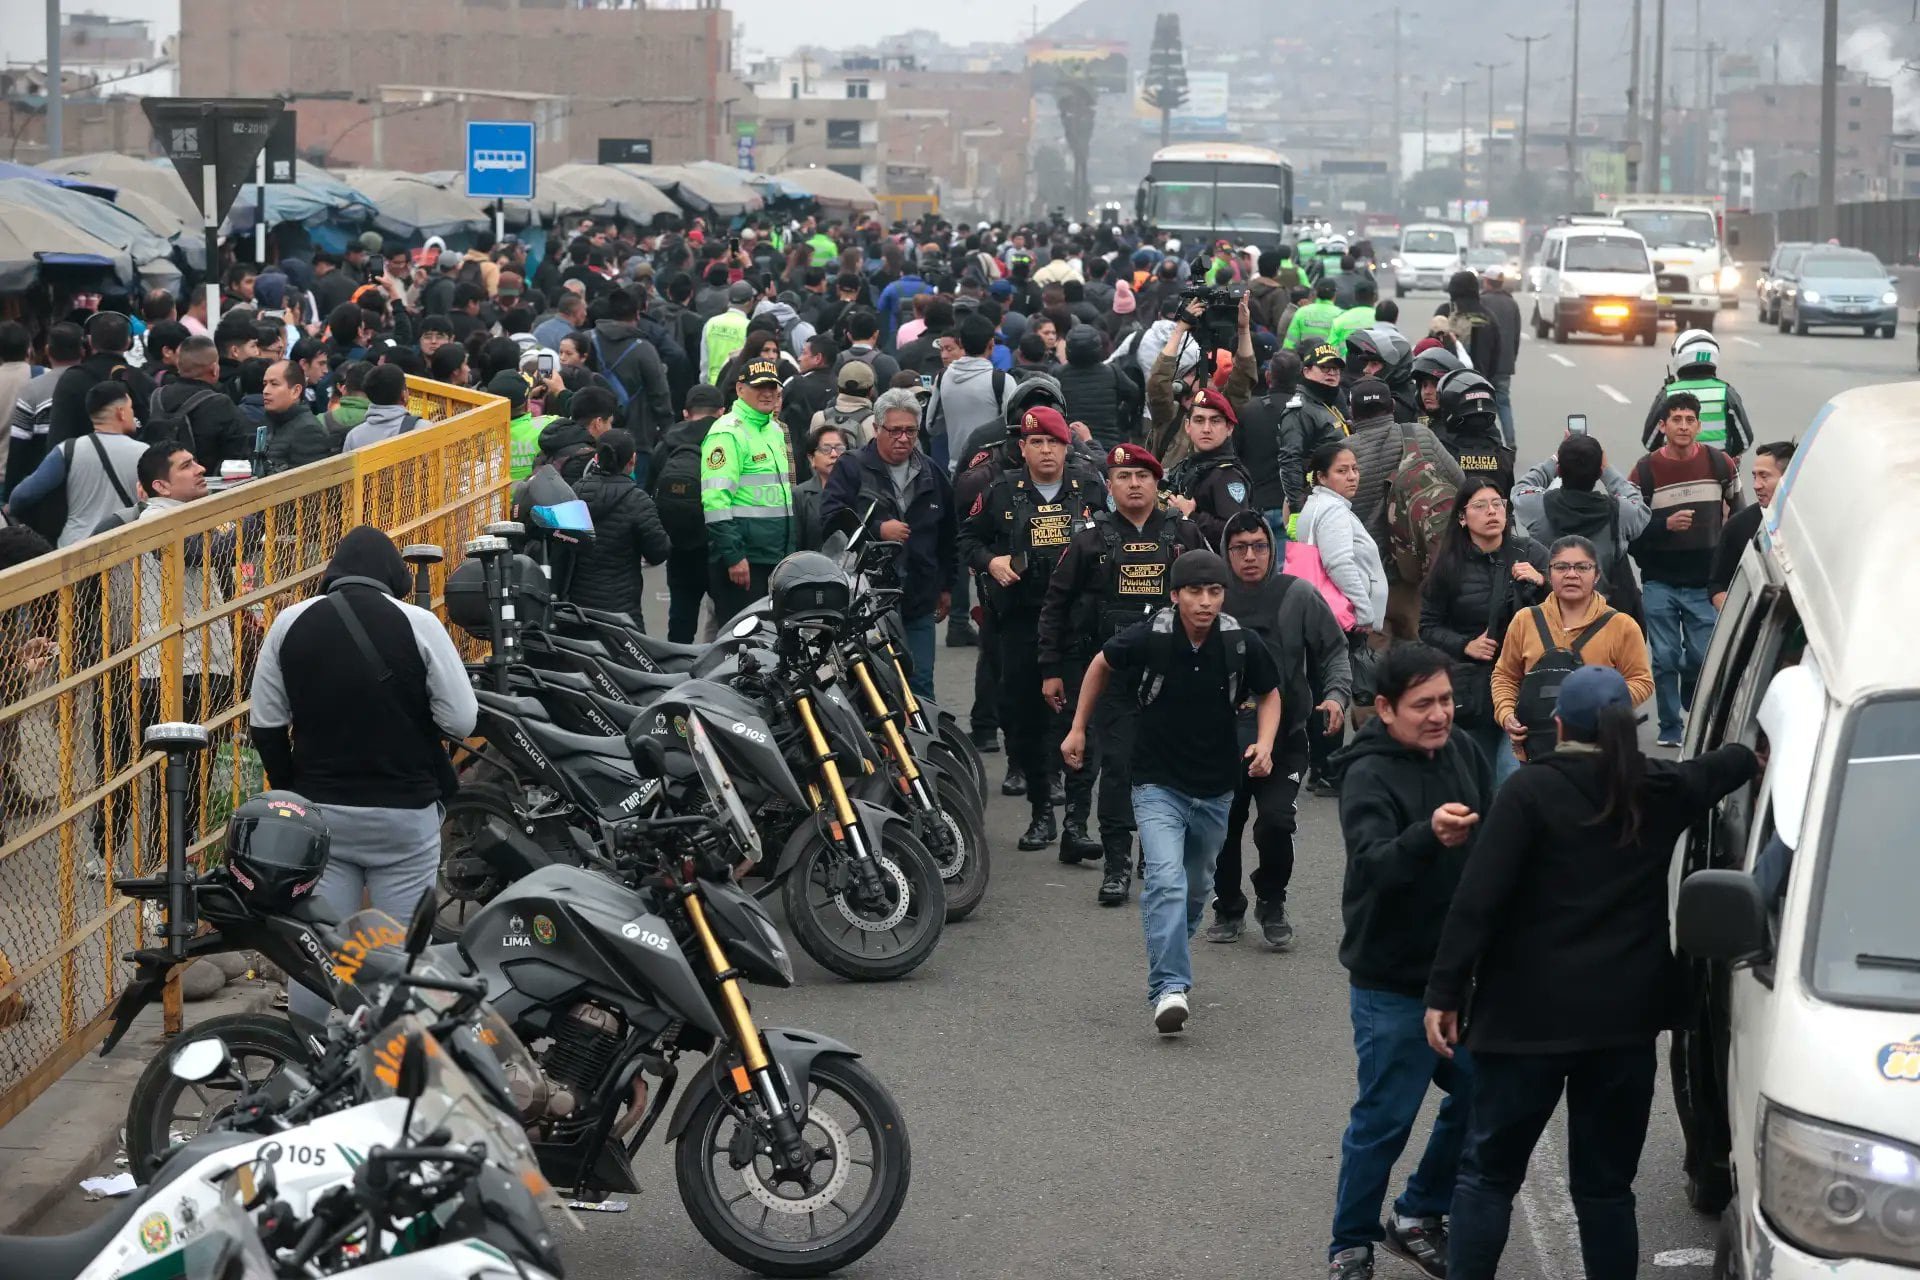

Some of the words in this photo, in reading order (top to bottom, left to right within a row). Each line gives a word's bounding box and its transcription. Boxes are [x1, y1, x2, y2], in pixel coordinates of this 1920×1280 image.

[1460, 456, 1498, 464] POLICIA
[1034, 528, 1062, 539] POLICIA
[1121, 577, 1152, 586] POLICIA
[1121, 585, 1160, 593] HALCONES
[624, 641, 653, 673] POLICÍA
[586, 709, 619, 737] POLICÍ
[745, 728, 767, 743] 105
[514, 731, 546, 770] POLICÍA
[502, 937, 532, 947] LIMA
[641, 930, 670, 951] 105
[288, 1144, 326, 1166] 105
